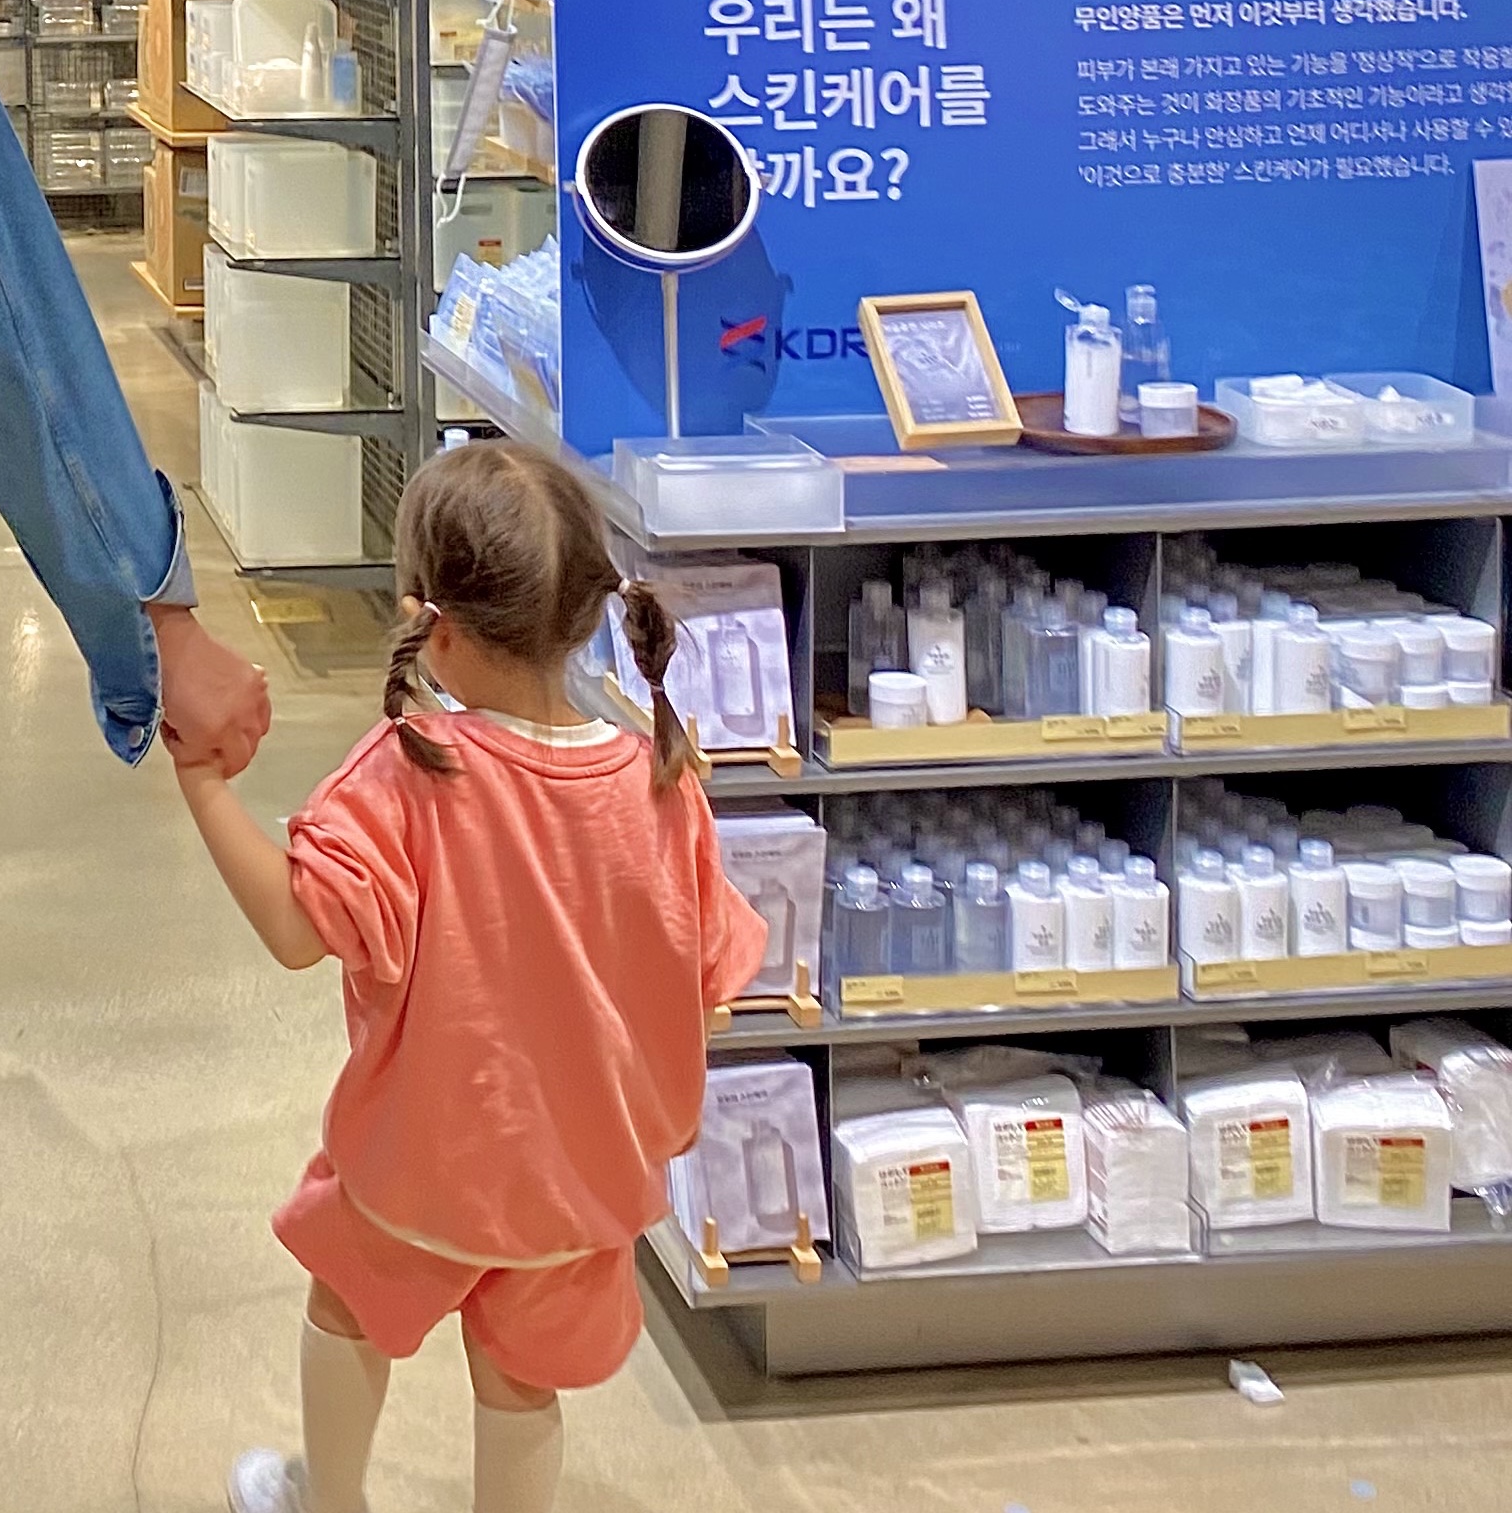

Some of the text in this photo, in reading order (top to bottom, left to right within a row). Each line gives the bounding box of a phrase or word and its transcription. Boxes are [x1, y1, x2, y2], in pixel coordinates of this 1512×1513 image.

[1074, 3, 1186, 32] 무인양품은
[1189, 1, 1233, 28] 먼저
[1239, 0, 1326, 27] 이것부터
[1077, 56, 1134, 82] 피부가
[1141, 55, 1180, 80] 본래
[1184, 54, 1243, 78] 가지고
[1246, 53, 1287, 76] 있는
[1291, 50, 1347, 75] 기능을
[708, 65, 991, 130] 스킨케어를
[1078, 93, 1156, 117] 도와주는
[1161, 91, 1199, 115] 것이
[1204, 88, 1282, 114] 화장품의
[1287, 85, 1364, 110] 기초적인
[1368, 83, 1464, 108] 기능이라고
[1078, 128, 1137, 153] 그래서
[1142, 126, 1200, 152] 누구나
[1205, 123, 1284, 149] 안심하고
[1287, 120, 1326, 146] 언제
[1330, 118, 1407, 144] 어디서나
[1413, 116, 1469, 141] 사용할
[1474, 117, 1494, 139] 수
[746, 146, 909, 208] 까요?
[1233, 157, 1329, 183] 스킨케어가
[1335, 151, 1455, 180] 필요했습니다.
